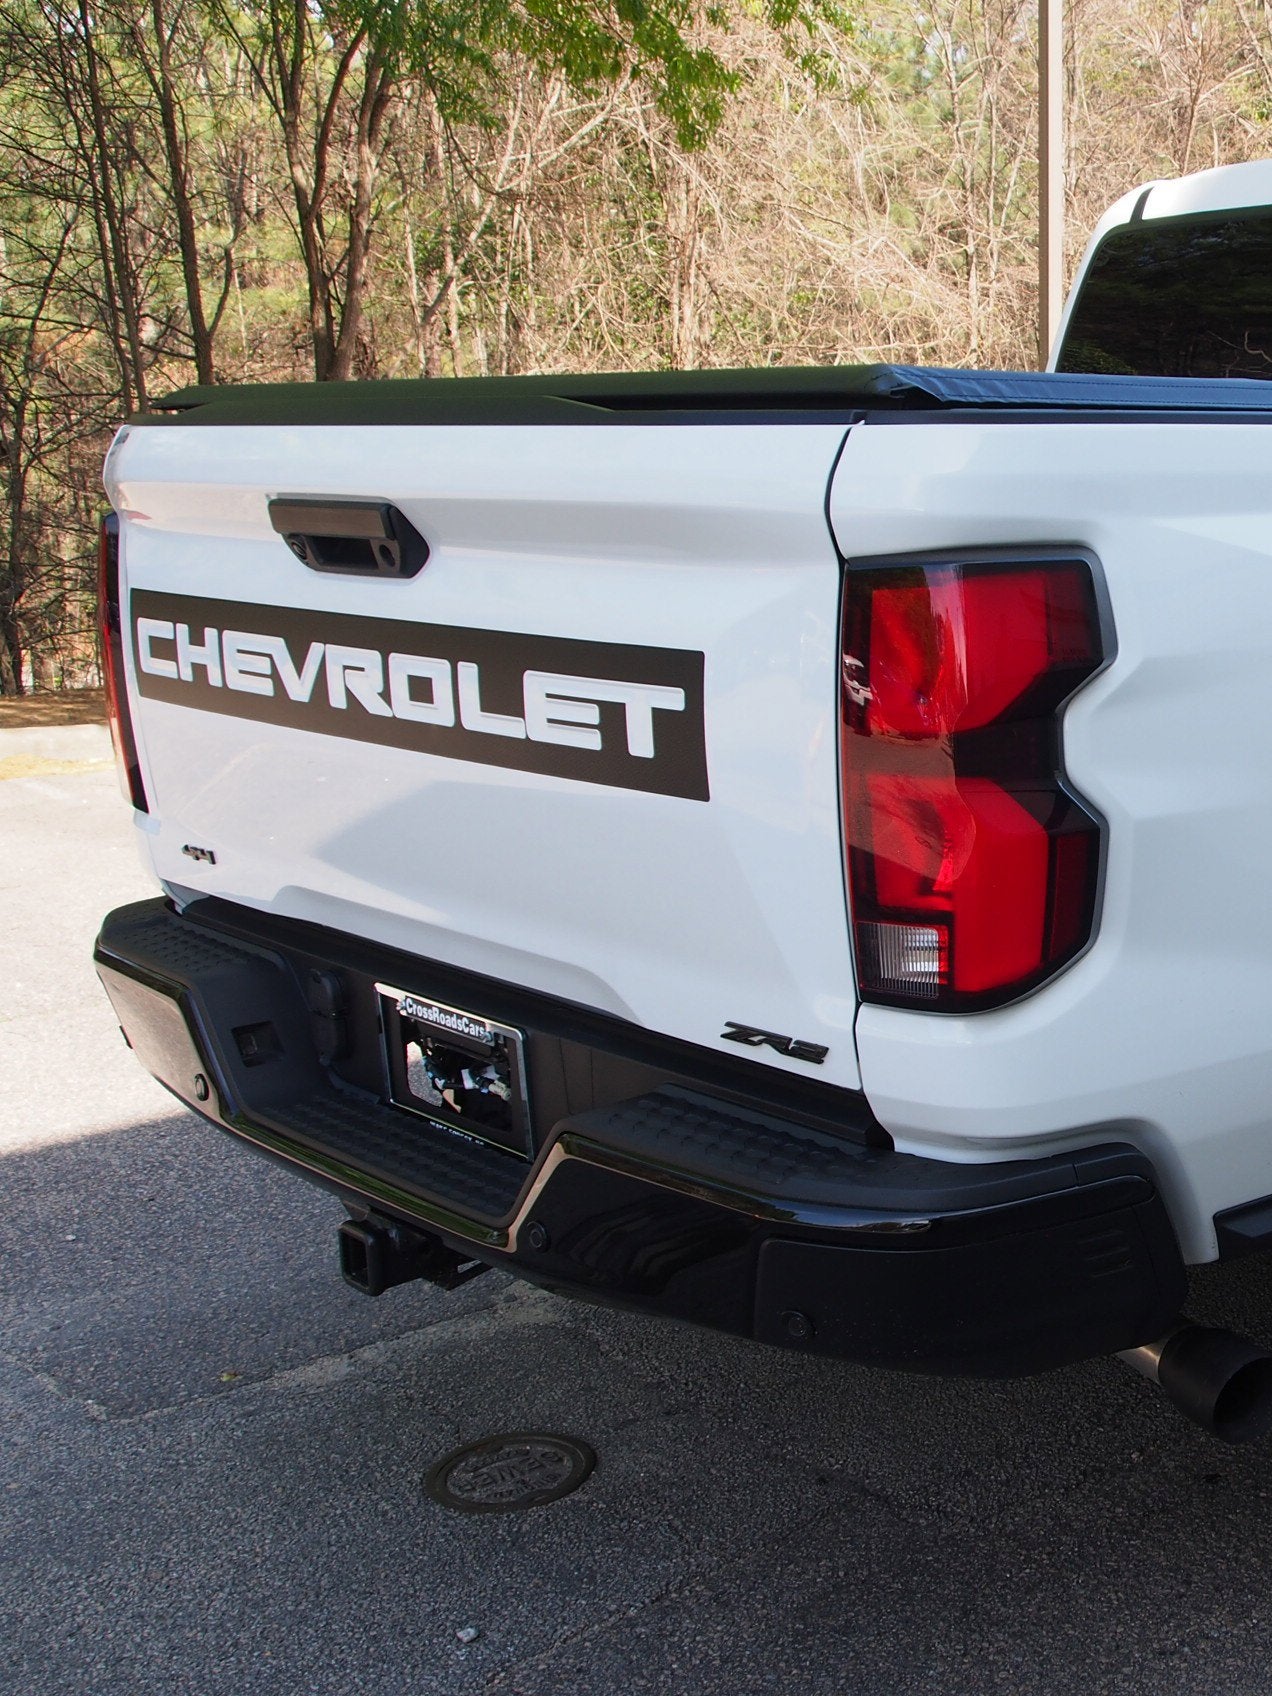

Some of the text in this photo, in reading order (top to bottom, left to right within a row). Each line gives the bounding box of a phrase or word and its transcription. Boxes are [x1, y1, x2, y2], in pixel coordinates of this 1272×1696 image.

[137, 617, 686, 759] CHEVROLET
[405, 997, 485, 1037] CrossRoadsCars
[720, 1021, 829, 1064] ZR2
